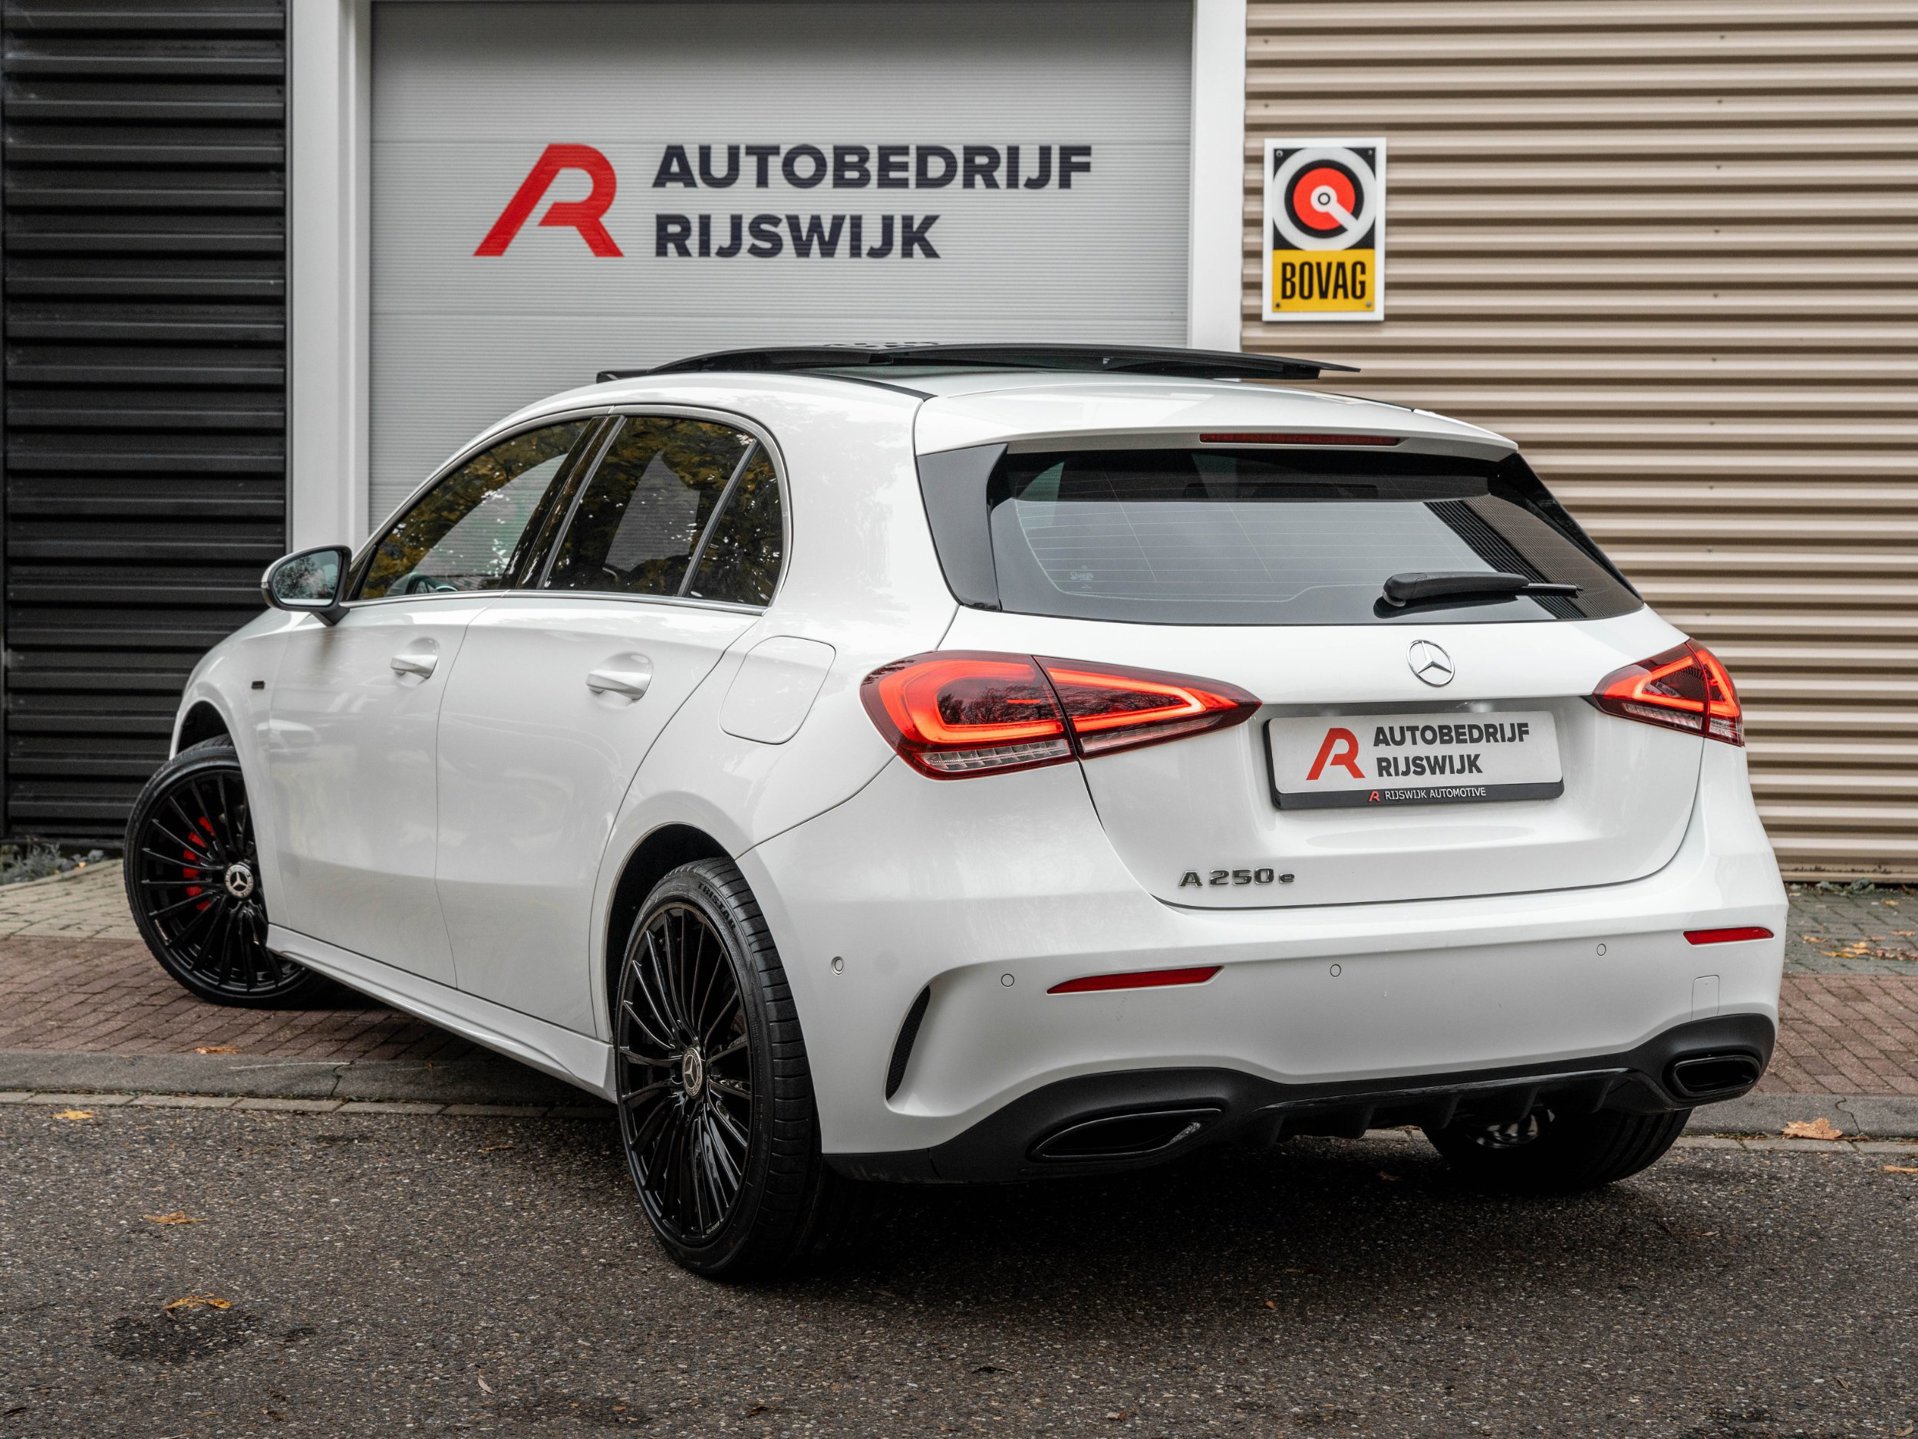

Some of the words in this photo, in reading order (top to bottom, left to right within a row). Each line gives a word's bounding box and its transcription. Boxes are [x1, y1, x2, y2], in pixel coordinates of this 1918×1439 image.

[652, 144, 1092, 189] AUTOBEDRIJF
[655, 214, 940, 258] RIJSWIJK
[1281, 261, 1366, 299] BOVAG
[1373, 722, 1530, 746] AUTOBEDRIJF
[1376, 754, 1483, 777] RIJSWIJK
[1385, 789, 1427, 800] RIJSWIJK
[1429, 786, 1487, 798] AUTOMOTIVE
